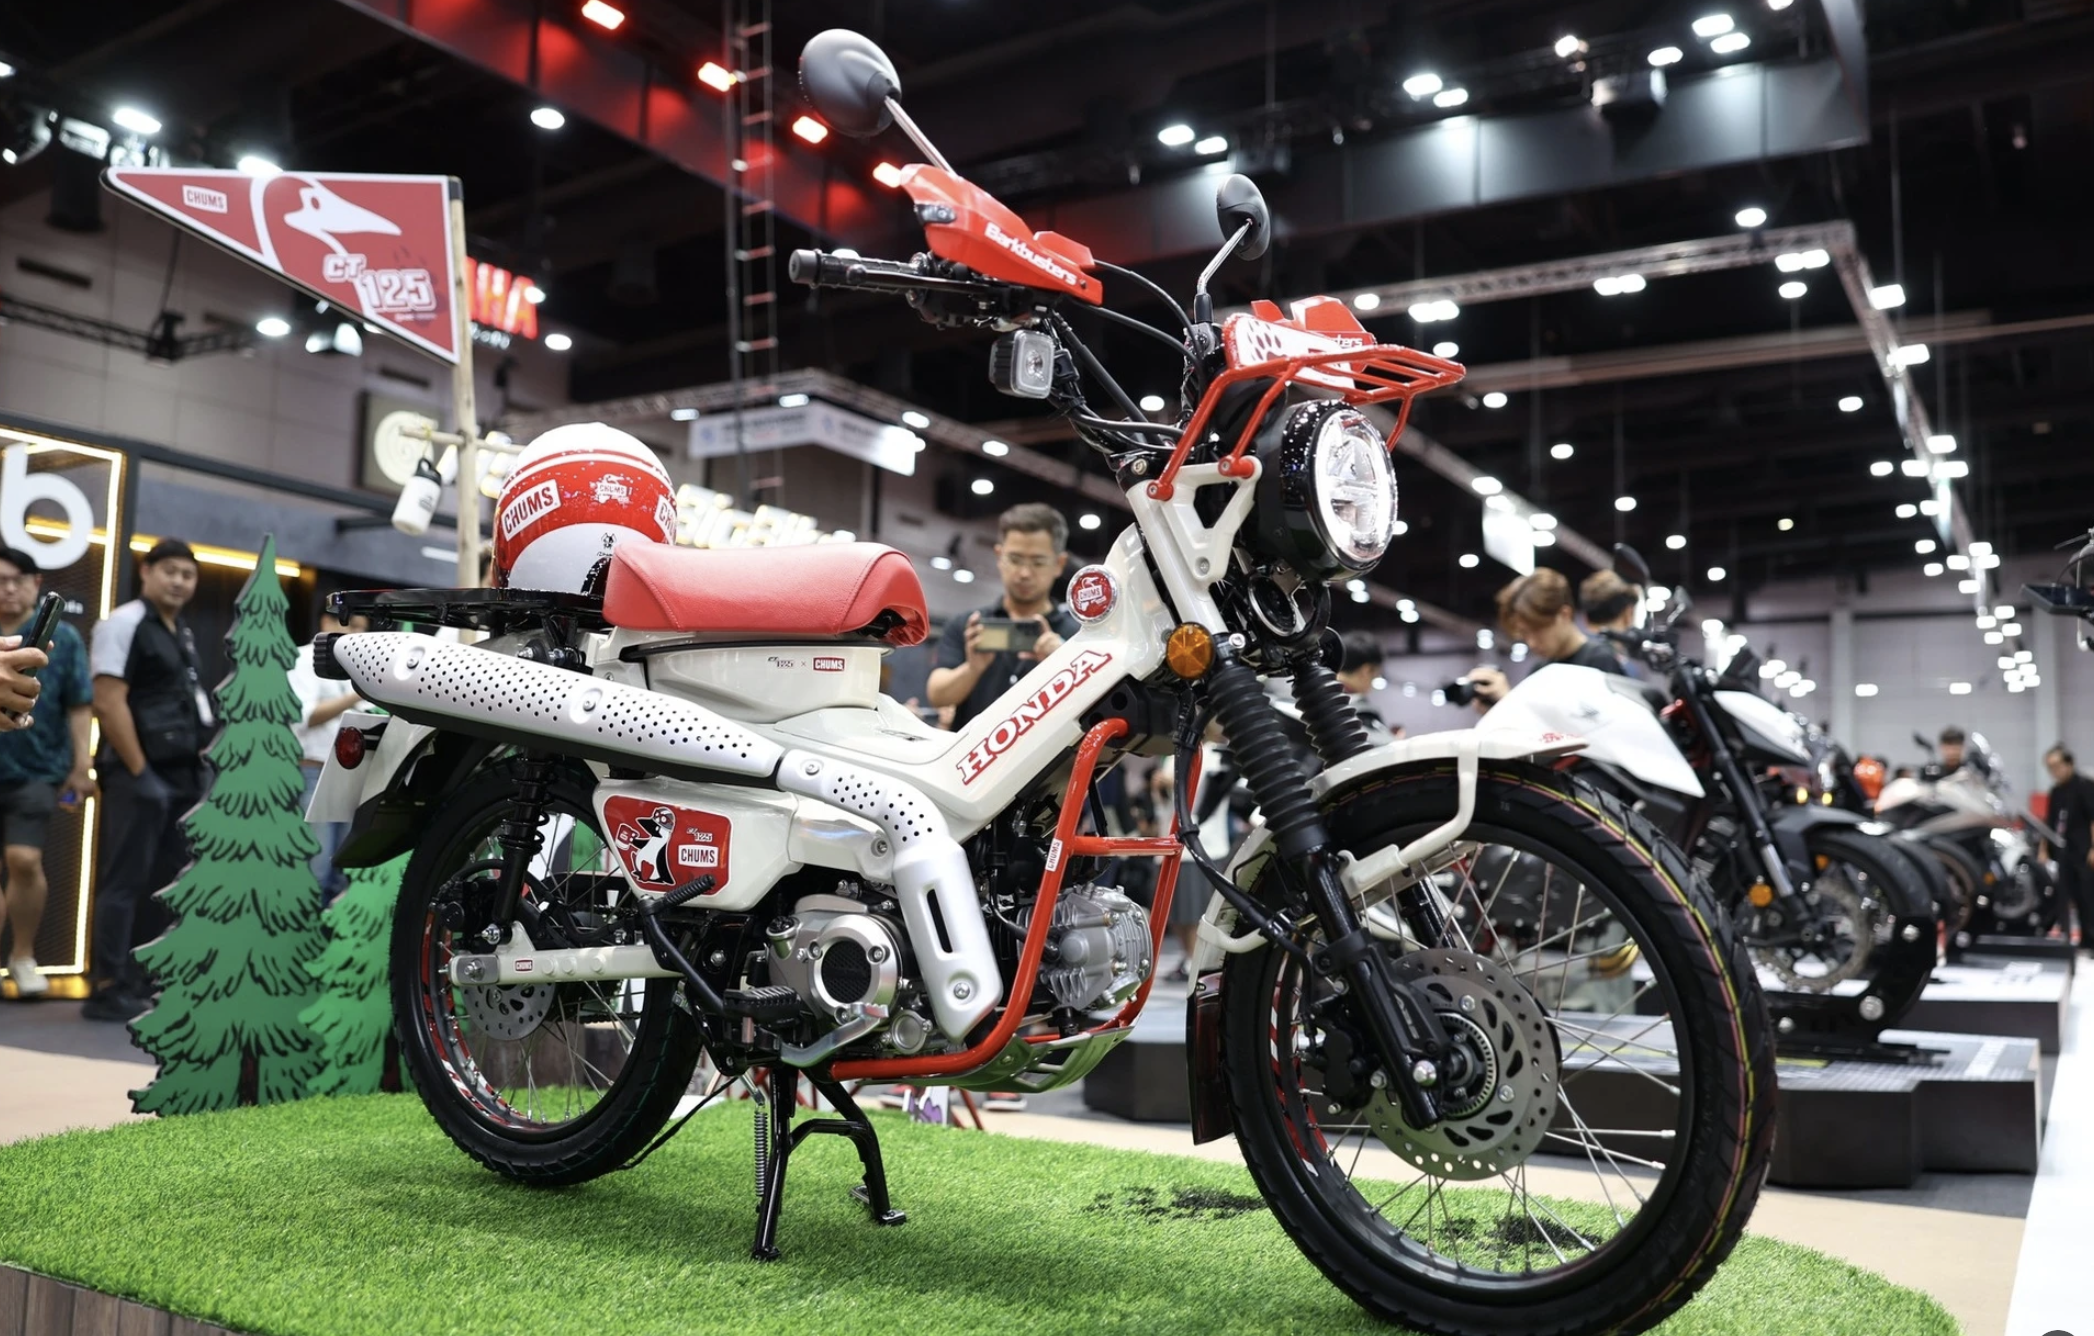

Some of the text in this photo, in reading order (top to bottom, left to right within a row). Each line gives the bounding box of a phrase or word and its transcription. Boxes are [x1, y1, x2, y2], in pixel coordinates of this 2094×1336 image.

[186, 189, 225, 210] CHUMS
[323, 253, 367, 283] CT
[984, 221, 1078, 286] Barkbusters
[361, 269, 437, 312] 125
[503, 486, 555, 535] CHUMS
[815, 659, 843, 670] CHUMS
[956, 650, 1113, 786] HONDA
[680, 847, 716, 864] CHUMS
